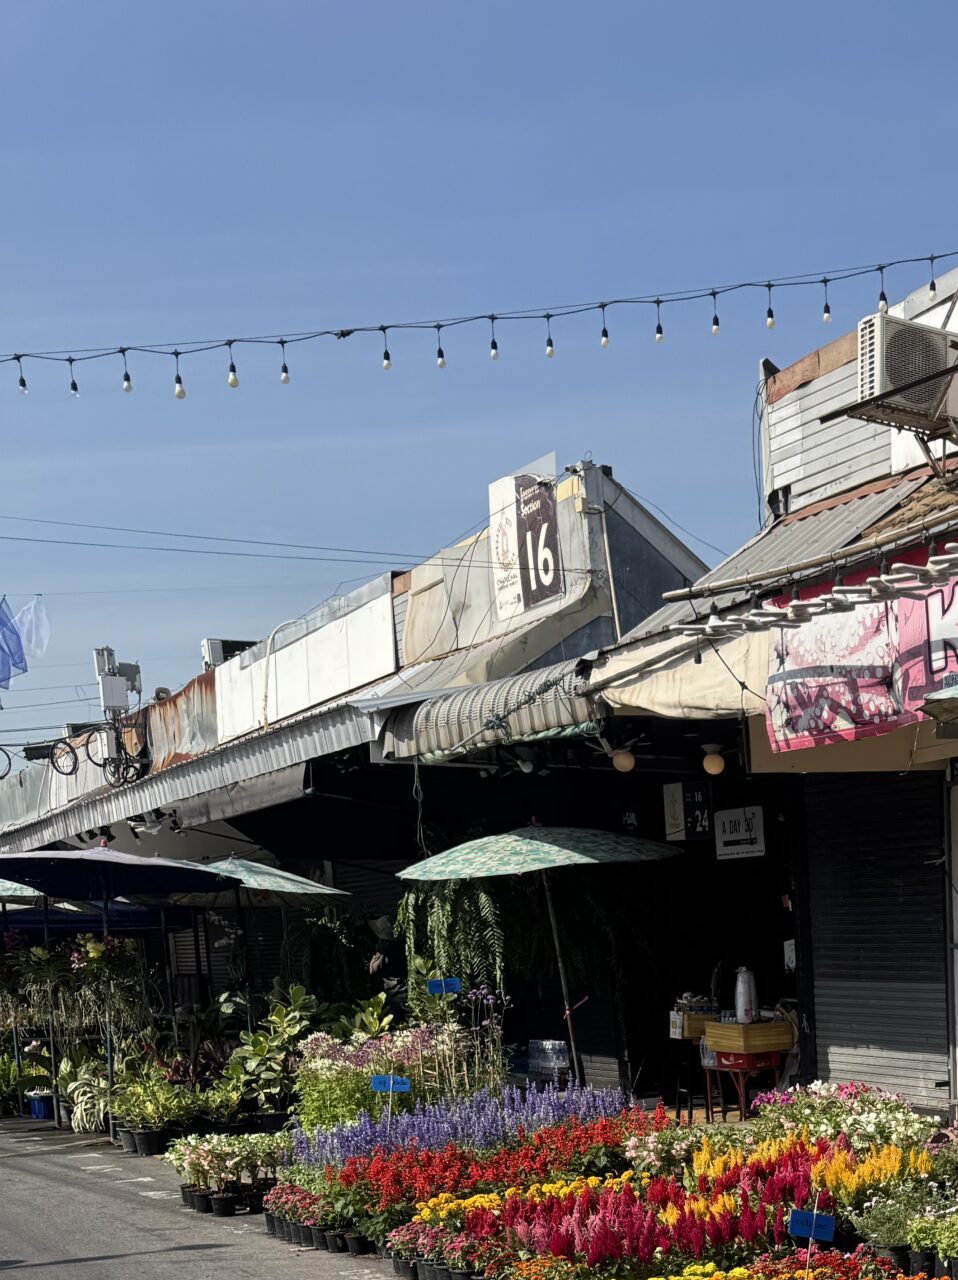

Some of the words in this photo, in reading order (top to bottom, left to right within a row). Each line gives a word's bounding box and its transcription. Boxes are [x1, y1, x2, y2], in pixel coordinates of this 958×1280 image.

[526, 522, 554, 591] 16
[694, 808, 709, 832] 24
[722, 820, 727, 836] A
[729, 817, 741, 835] DAY
